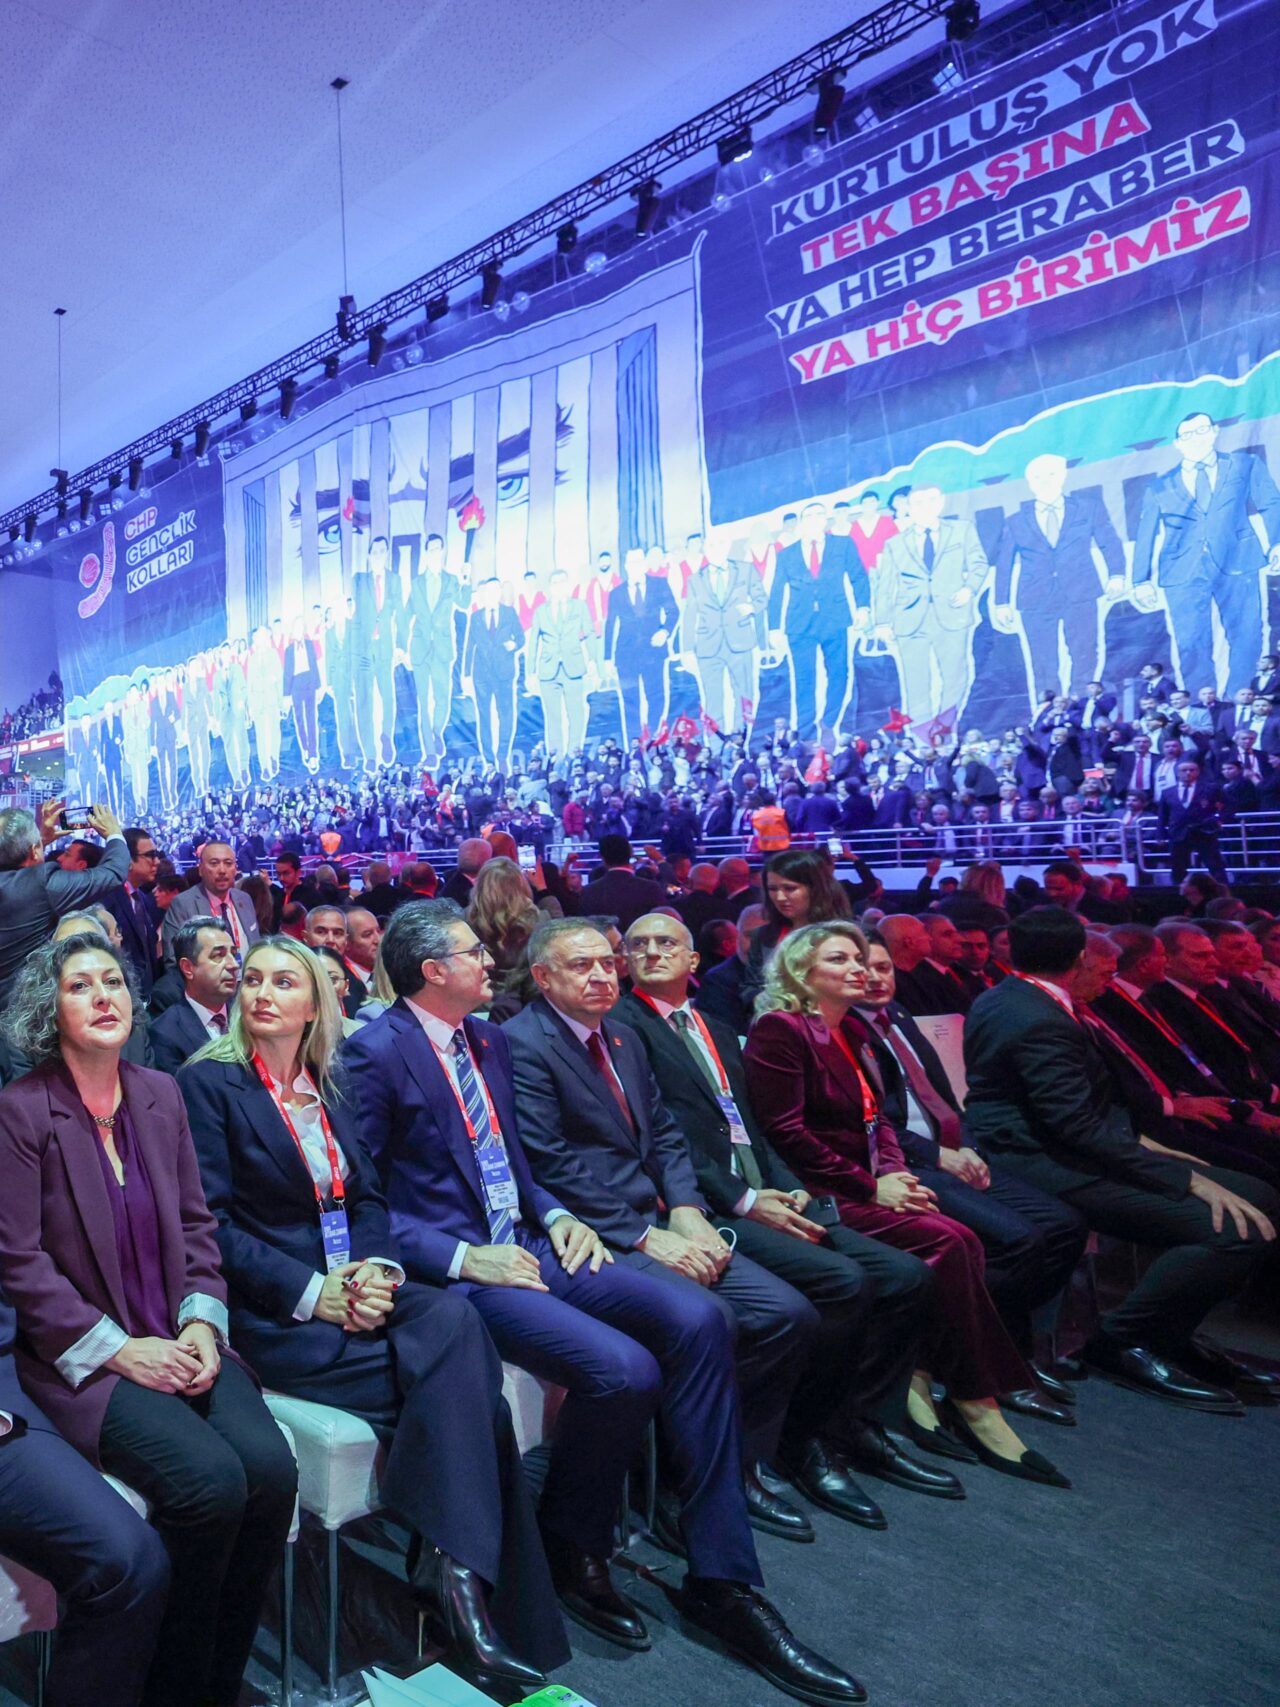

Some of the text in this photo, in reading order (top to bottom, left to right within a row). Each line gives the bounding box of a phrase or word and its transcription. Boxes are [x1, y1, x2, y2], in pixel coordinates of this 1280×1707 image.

[773, 0, 1217, 236] KURTULUŞ YOK
[801, 102, 1150, 270] TEK BAŞINA
[768, 123, 1241, 337] YA HEP BERABER
[792, 190, 1250, 382] YA HİÇ BİRİMİZ
[125, 508, 157, 539] CHP
[128, 511, 196, 565] GENÇLİK
[128, 542, 193, 592] KOLLARI
